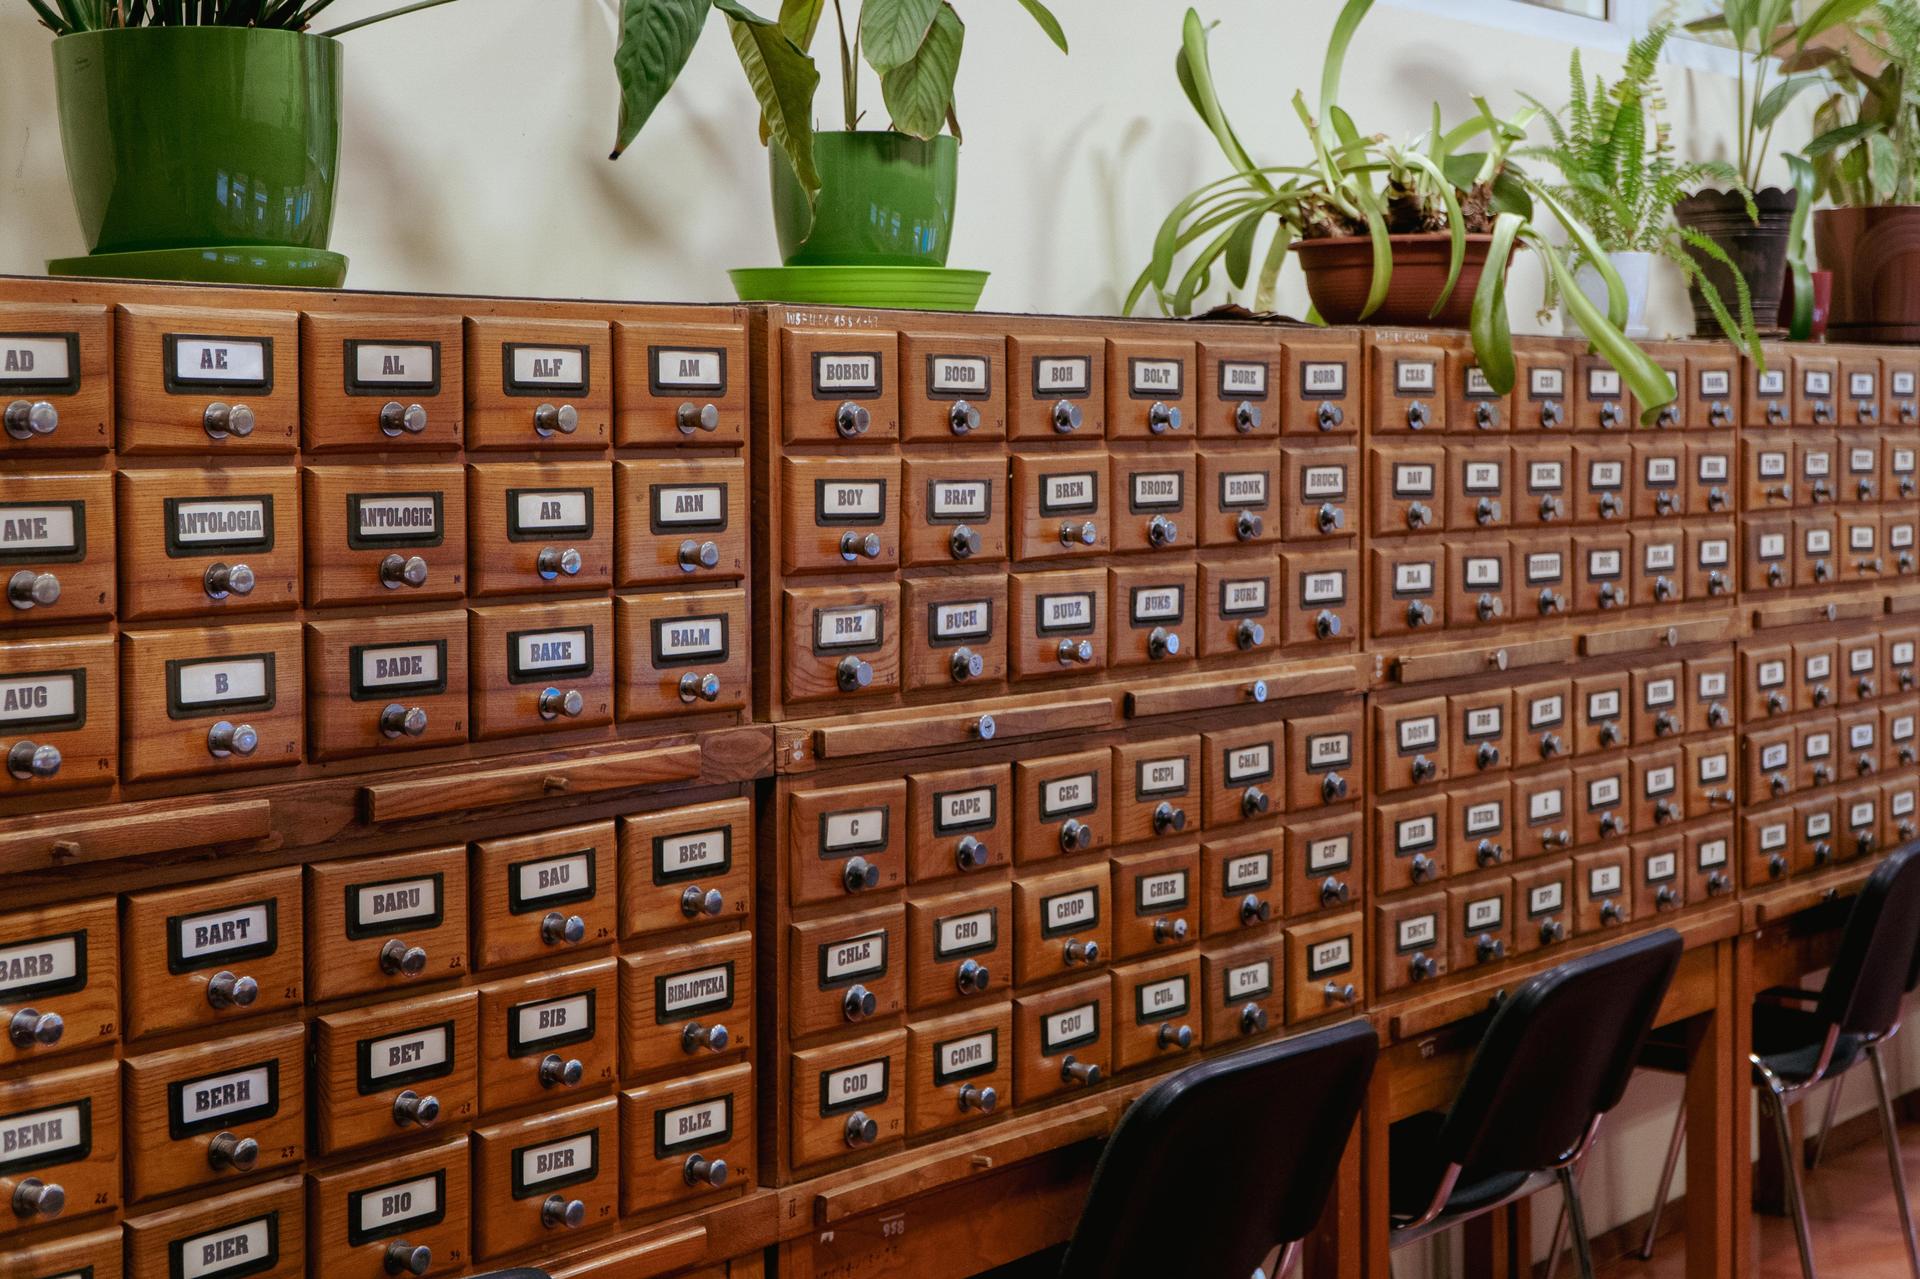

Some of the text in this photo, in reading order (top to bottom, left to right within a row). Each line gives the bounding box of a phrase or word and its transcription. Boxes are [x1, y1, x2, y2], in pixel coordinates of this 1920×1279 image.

[4, 349, 35, 373] AD
[199, 347, 229, 371] AE
[381, 355, 405, 376] AL
[532, 358, 563, 378] ALF
[678, 358, 700, 378] AM
[827, 364, 869, 380] BOBRU
[944, 365, 976, 383] BOGD
[1051, 366, 1074, 383] BOH
[1143, 367, 1171, 384] BOLT
[1231, 369, 1257, 385] BORE
[286, 425, 293, 437] 3
[599, 423, 604, 435] 5
[837, 488, 864, 507] BOY
[943, 488, 977, 506] BRAT
[1055, 480, 1084, 500] BREN
[1140, 480, 1174, 496] BRODZ
[1229, 479, 1261, 496] BRONK
[539, 501, 562, 521] AR
[674, 493, 704, 514] ARN
[3, 517, 48, 541] ANE
[1144, 594, 1171, 612] BUKS
[835, 615, 863, 635] BRZ
[945, 609, 978, 631] BUCH
[671, 628, 710, 647] BALM
[531, 641, 571, 662] BAKE
[376, 656, 422, 678] BADE
[214, 672, 229, 695] B
[4, 686, 47, 711] AUG
[1151, 766, 1174, 783] CEPI
[1058, 784, 1080, 803] CEC
[950, 796, 981, 817] CAPE
[850, 818, 860, 837] C
[678, 841, 707, 864] BEC
[1322, 843, 1338, 860] CIF
[538, 863, 570, 890] BAU
[1237, 860, 1260, 879] CICH
[373, 888, 420, 915] BARU
[1056, 898, 1085, 920] CHOP
[195, 917, 250, 948] BART
[954, 920, 979, 941] CHO
[449, 957, 462, 968] 22
[837, 942, 871, 967] CHLE
[1239, 969, 1259, 987] CYK
[284, 988, 297, 999] 21
[668, 975, 724, 1004] BIBLIOTEKA
[1153, 987, 1174, 1007] CUL
[538, 1007, 567, 1030] BIB
[1060, 1014, 1082, 1035] COU
[99, 1023, 113, 1036] 20
[389, 1041, 424, 1067] BET
[950, 1043, 983, 1067] CONR
[842, 1073, 868, 1095] COD
[195, 1080, 250, 1113] BERH
[678, 1109, 712, 1136] BLIZ
[3, 1119, 63, 1153] BENH
[280, 1145, 295, 1158] 27
[537, 1149, 574, 1174] BJER
[381, 1191, 412, 1218] BIO
[203, 1234, 248, 1266] BIER
